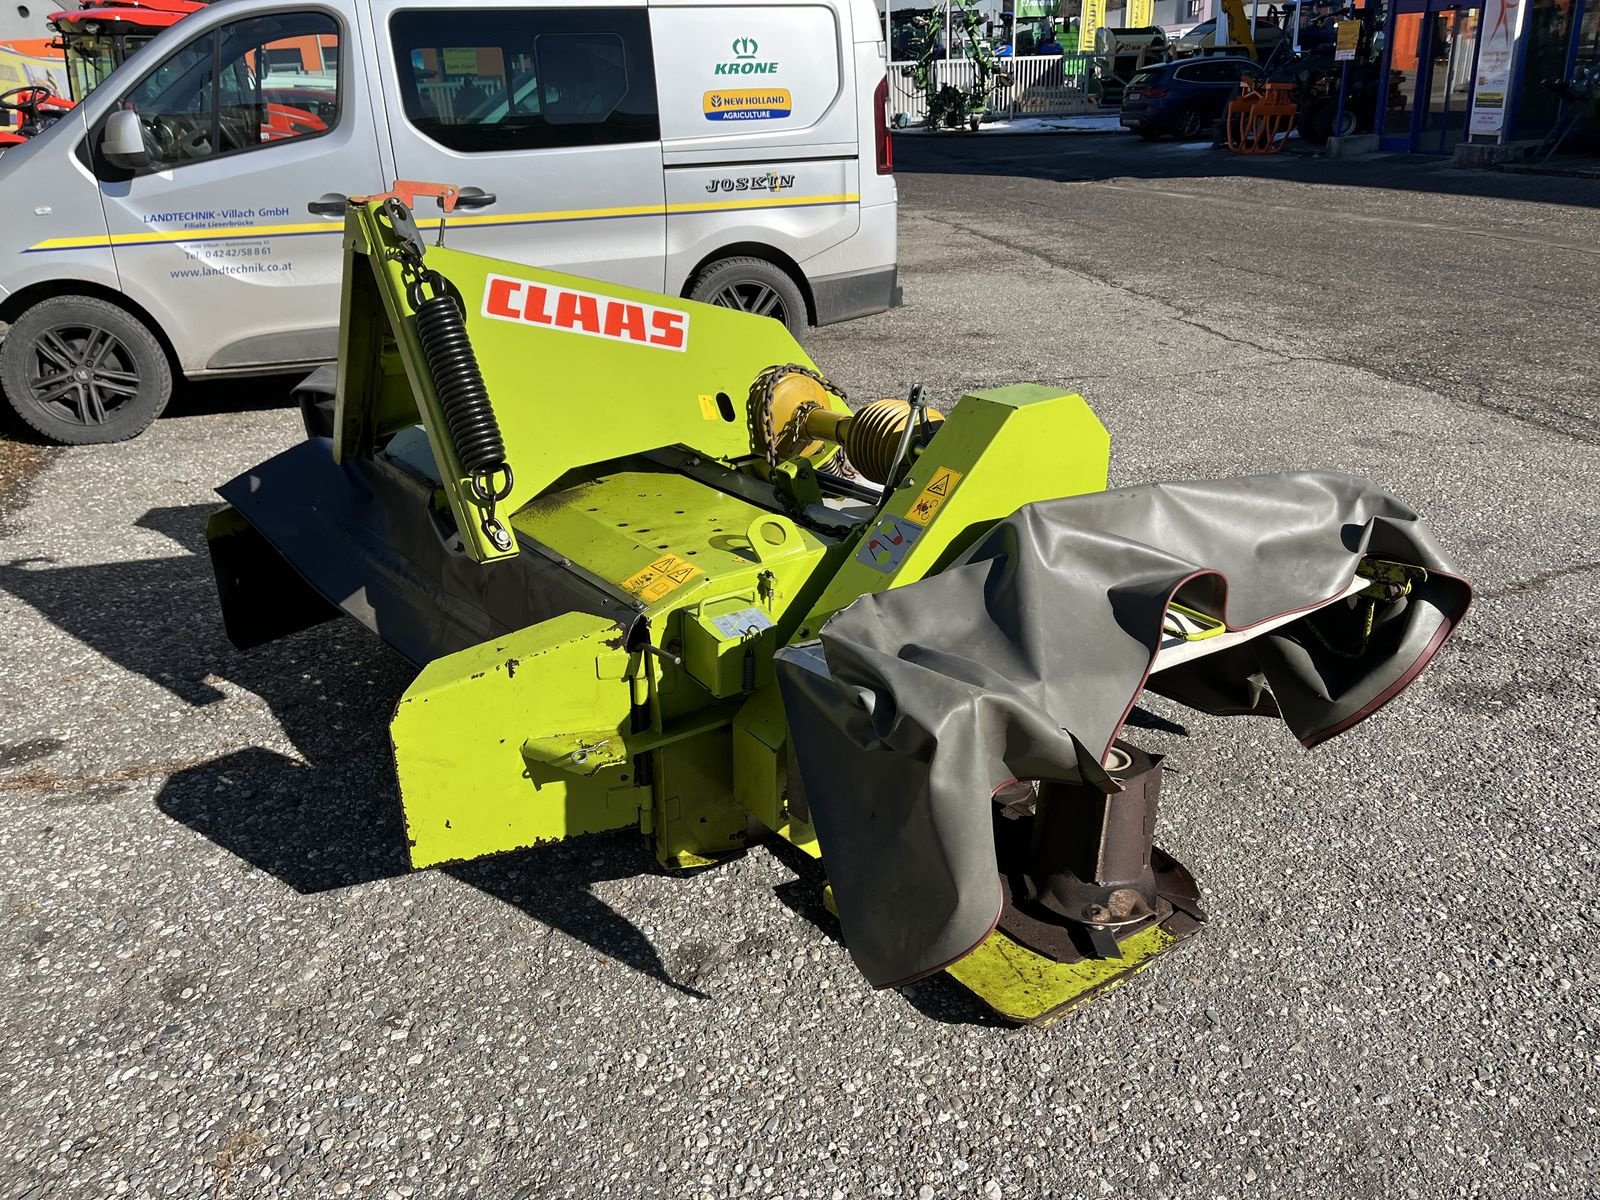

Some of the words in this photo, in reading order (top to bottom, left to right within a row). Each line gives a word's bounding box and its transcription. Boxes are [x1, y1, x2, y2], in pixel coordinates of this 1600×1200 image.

[714, 62, 779, 75] KRONE
[724, 97, 744, 106] NEW
[746, 96, 785, 105] HOLLAND
[723, 110, 771, 119] AGRICULTURE
[705, 174, 796, 193] JOSKIN
[258, 207, 289, 217] GmbH
[184, 221, 206, 229] Filiale
[207, 219, 254, 228] Lieserbrücke
[185, 251, 201, 260] Tel.
[170, 262, 293, 278] www.landtechnik.co.at
[486, 278, 684, 348] CLAAS
